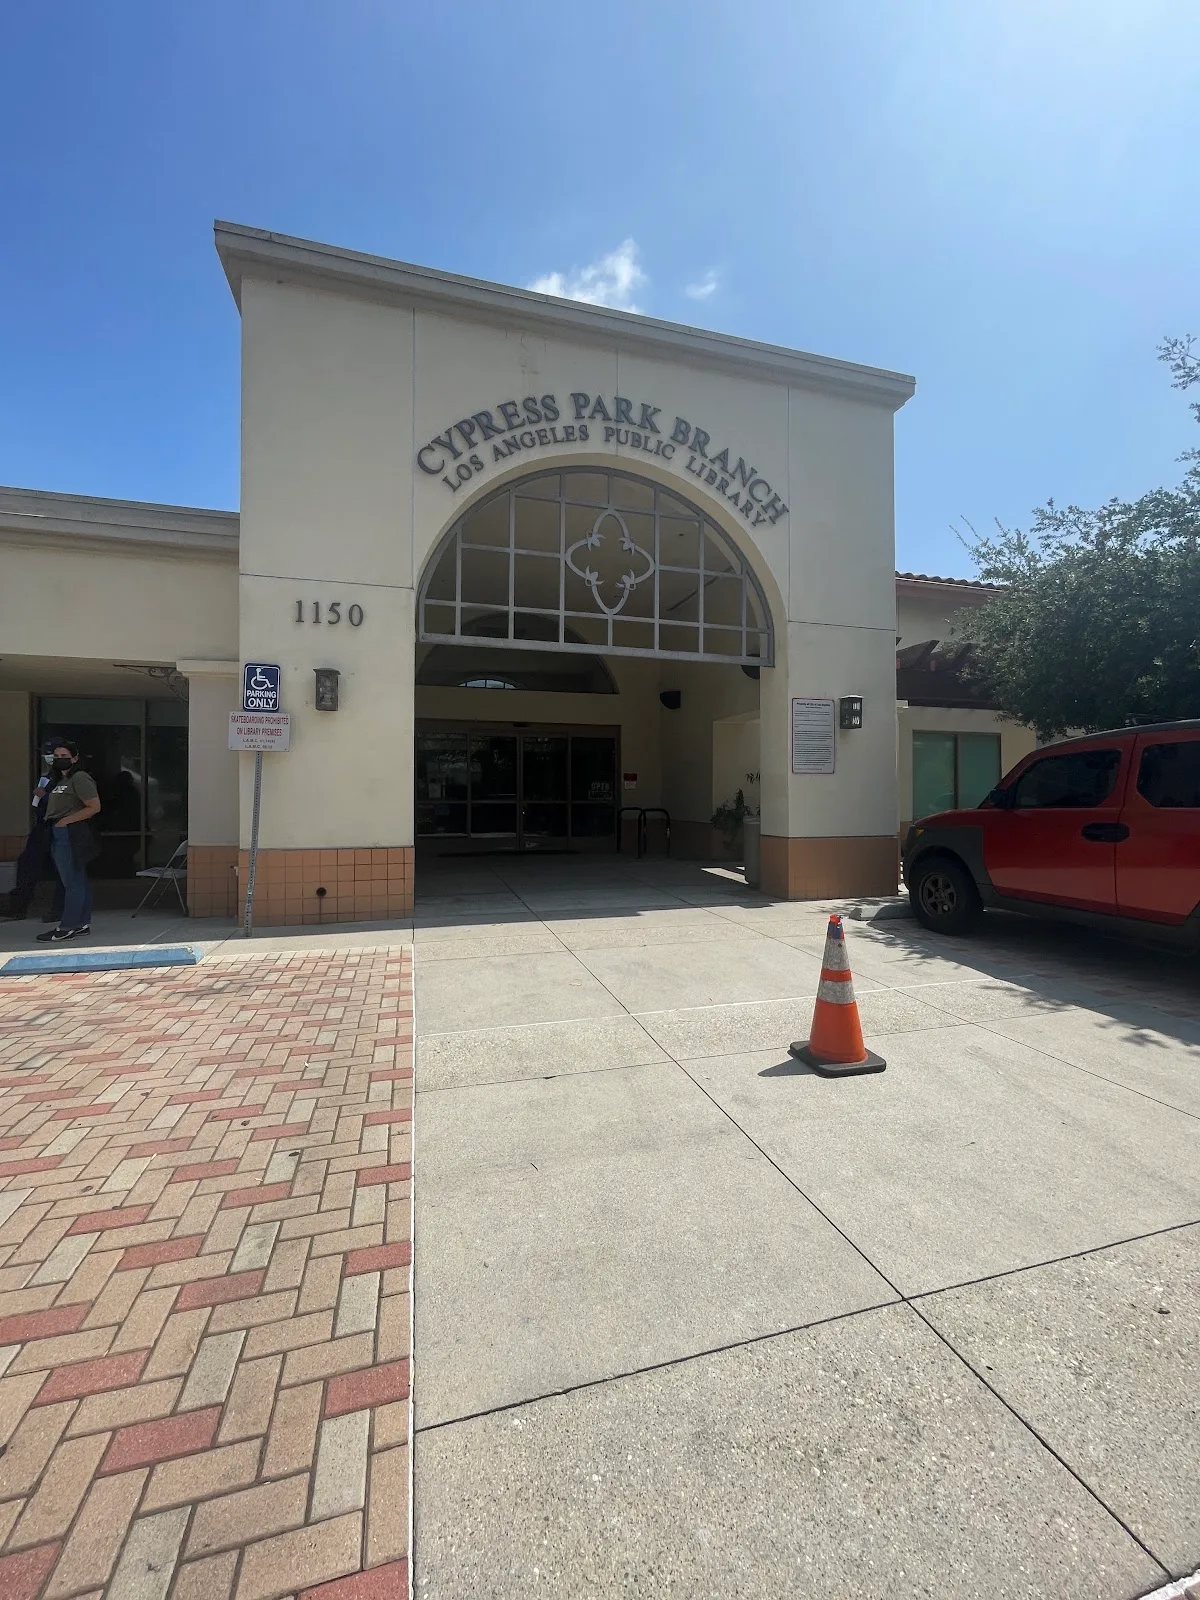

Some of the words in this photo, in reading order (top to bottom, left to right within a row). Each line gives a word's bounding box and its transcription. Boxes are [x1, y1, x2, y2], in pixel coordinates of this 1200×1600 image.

[416, 393, 560, 475] CYPRESS
[570, 392, 662, 434] PARK
[671, 416, 789, 525] BRANCH
[442, 453, 485, 493] LOS
[492, 424, 590, 462] ANGELES
[604, 425, 676, 461] PUBLIC
[685, 455, 767, 529] LIBRARY
[295, 599, 364, 627] 1150
[246, 689, 277, 698] PARKING
[248, 697, 275, 708] ONLY
[231, 715, 264, 725] SKATEBOARDING
[264, 716, 289, 725] PROHIBITED
[236, 727, 243, 735] ON
[243, 727, 261, 736] LIBRARY
[261, 728, 283, 737] PREMISES
